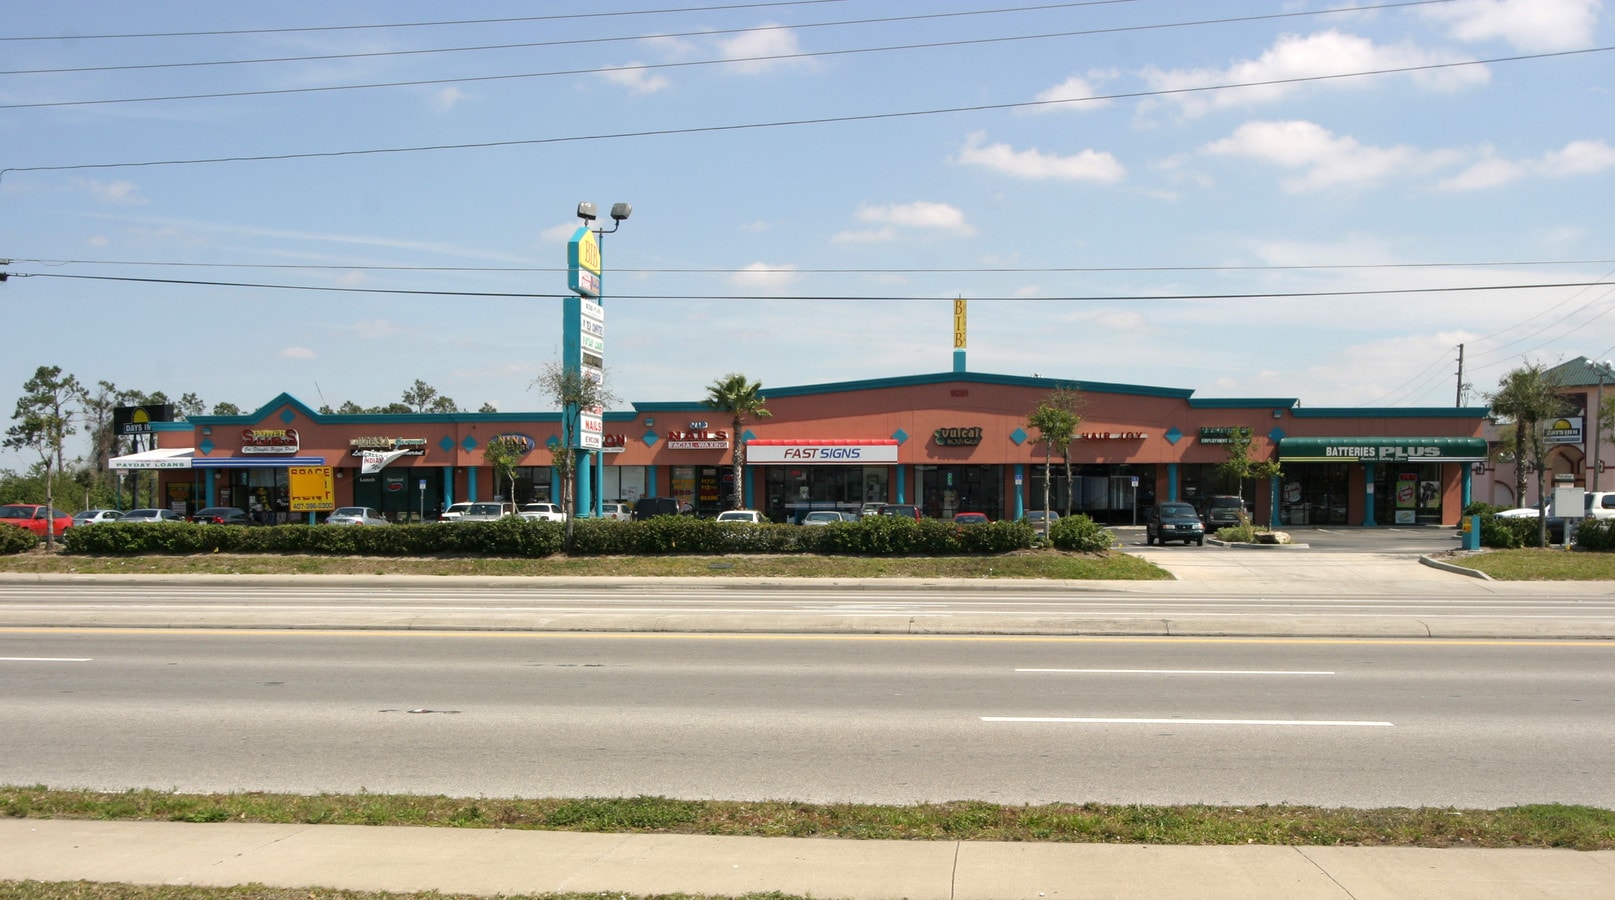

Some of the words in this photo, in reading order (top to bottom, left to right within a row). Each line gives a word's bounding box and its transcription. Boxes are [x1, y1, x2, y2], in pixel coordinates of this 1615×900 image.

[125, 424, 142, 432] DAYS
[585, 420, 602, 432] NAILS
[668, 430, 728, 440] NAILS
[1326, 446, 1376, 457] BATTERIES
[1379, 446, 1441, 457] PLUS
